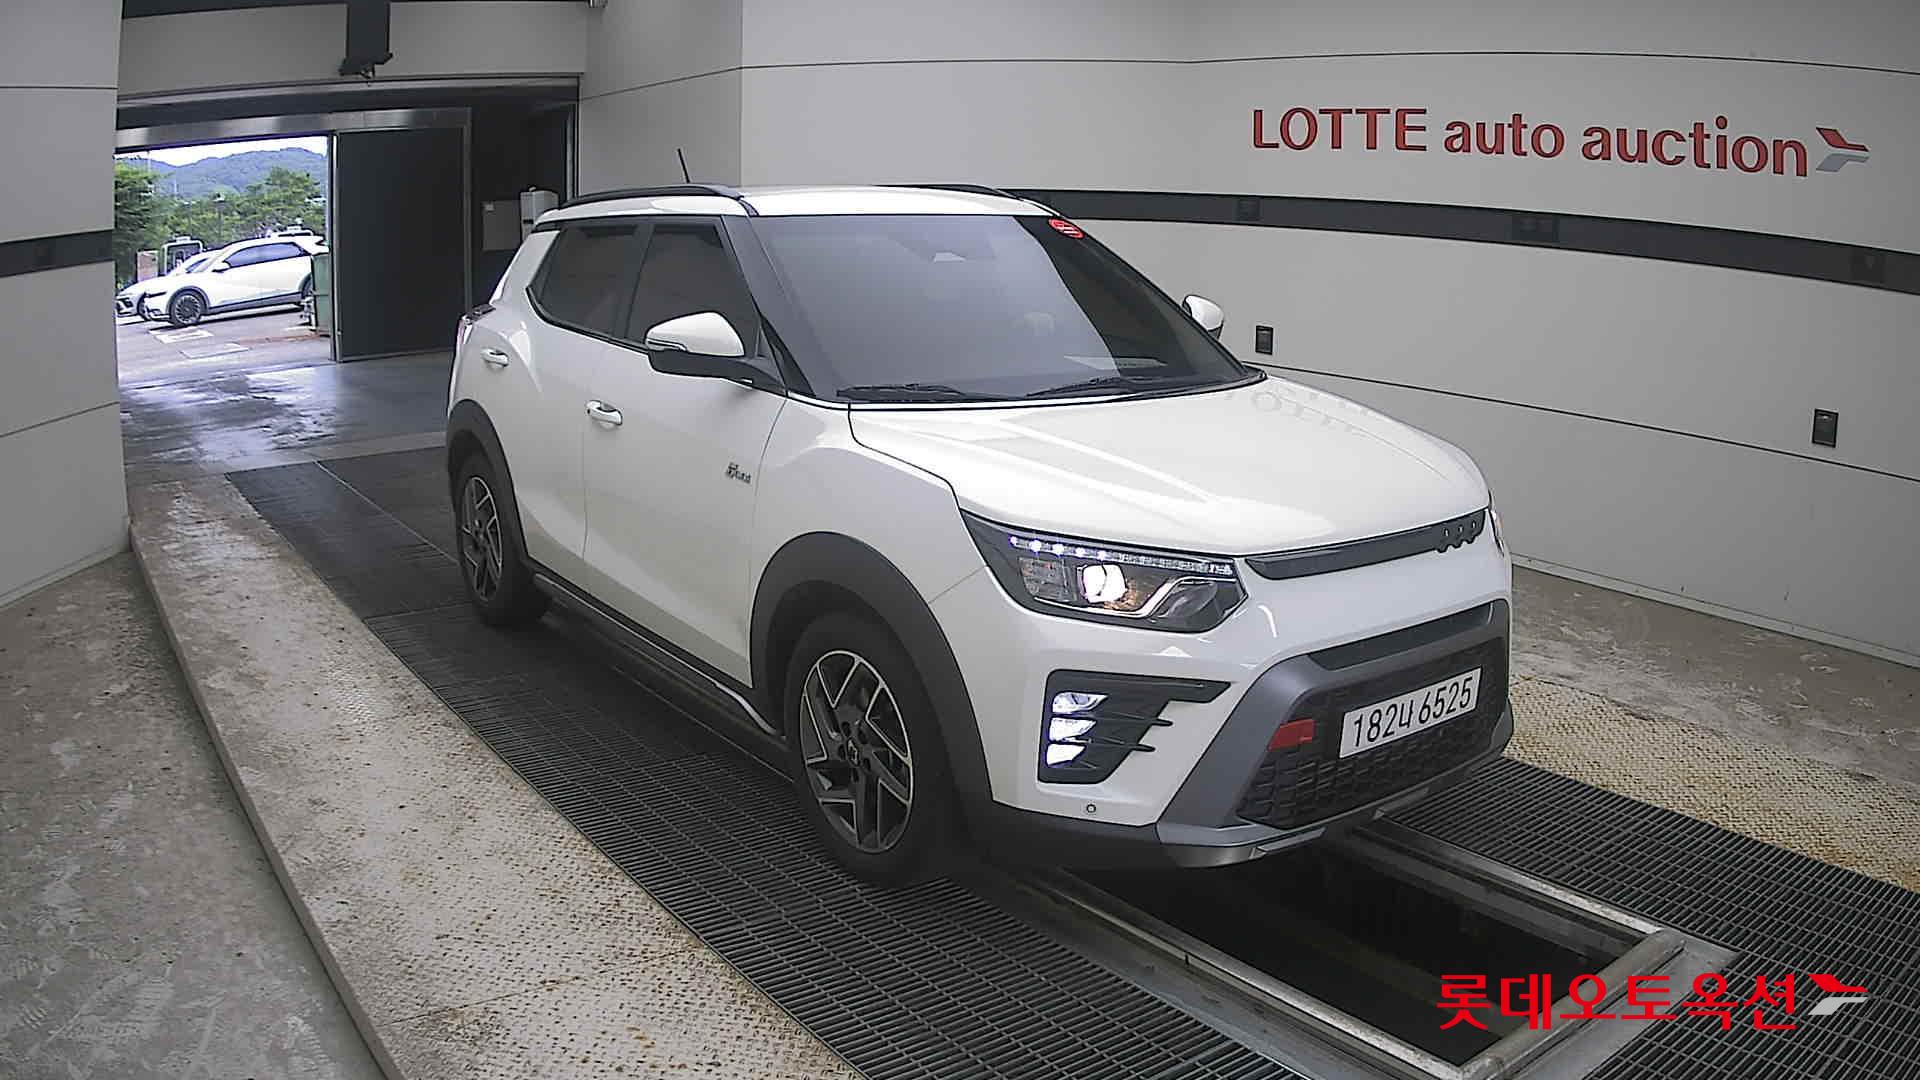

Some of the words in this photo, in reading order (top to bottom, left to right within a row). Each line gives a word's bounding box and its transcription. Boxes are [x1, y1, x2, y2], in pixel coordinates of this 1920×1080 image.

[1253, 107, 1427, 151] LOTTE
[1443, 114, 1567, 158] auto
[1581, 116, 1809, 178] auction
[1418, 676, 1473, 724] 6525
